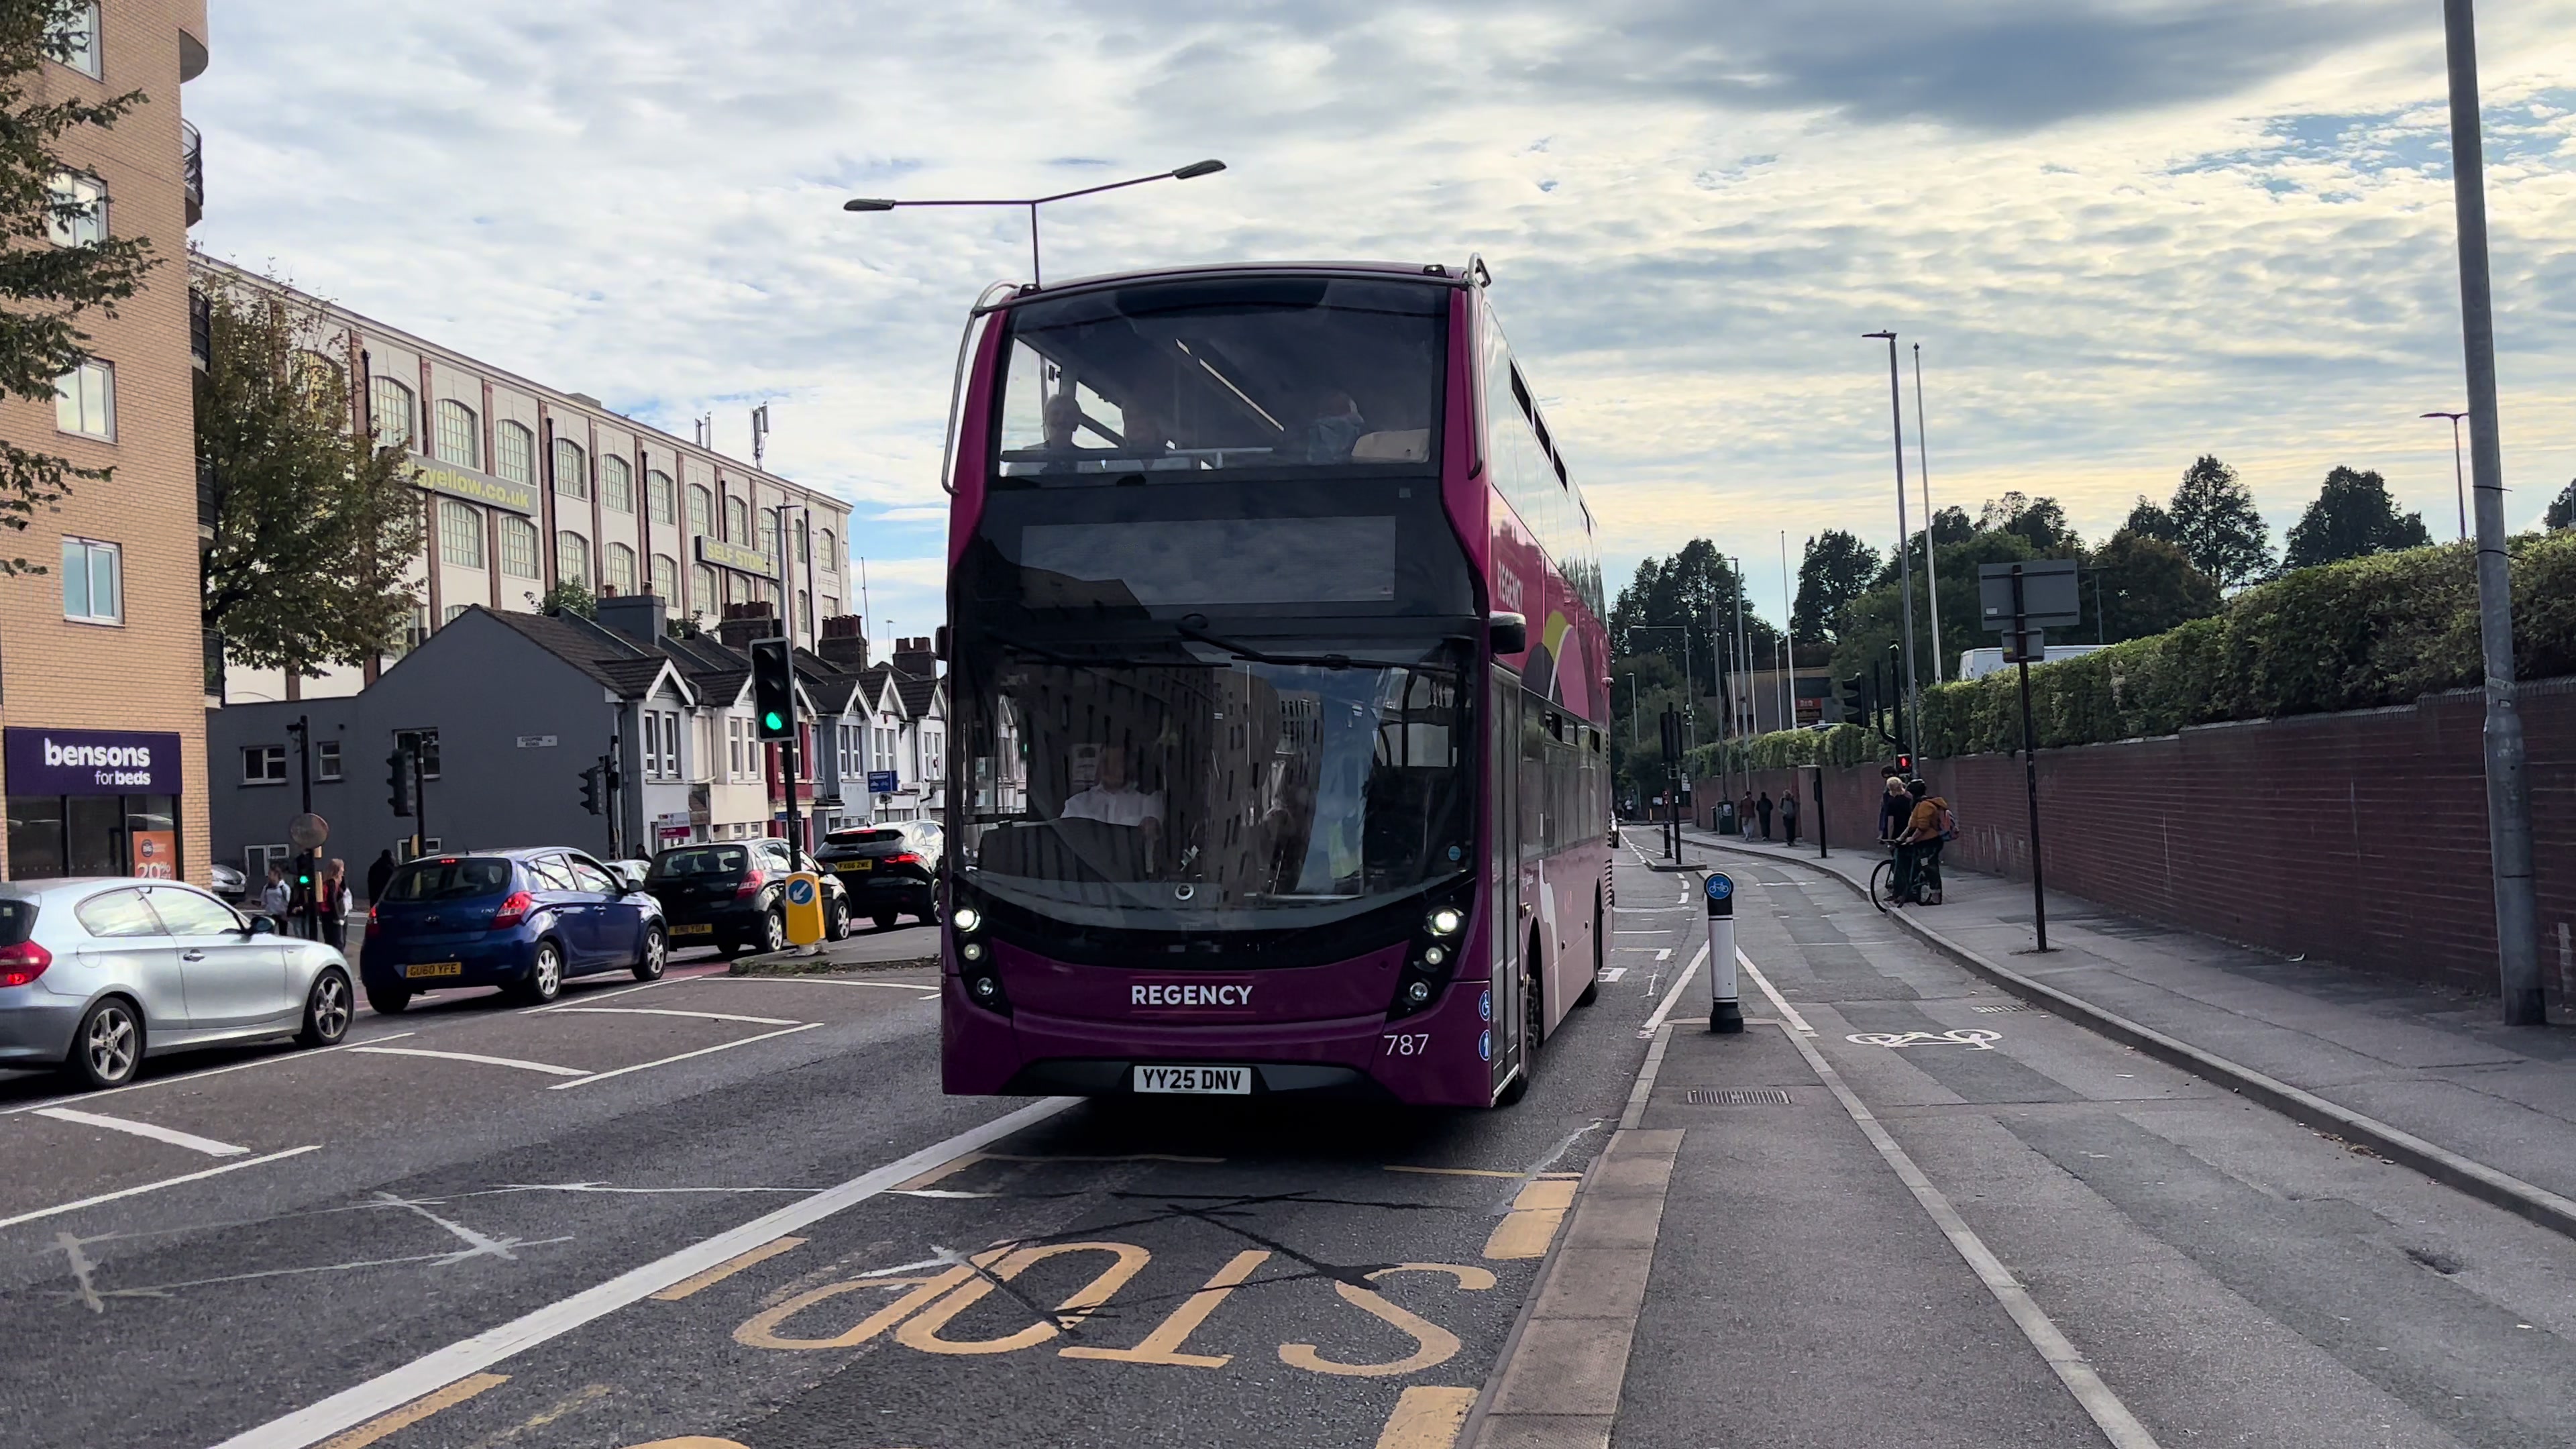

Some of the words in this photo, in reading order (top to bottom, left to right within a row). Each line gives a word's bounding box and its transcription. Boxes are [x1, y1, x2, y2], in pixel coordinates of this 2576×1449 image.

[706, 541, 733, 563] SELF
[1497, 558, 1523, 613] REGENCY
[44, 737, 151, 767] bensons
[95, 771, 113, 785] for
[115, 771, 151, 785] beds
[1132, 985, 1253, 1005] REGENCY
[1383, 1034, 1430, 1056] 787
[1142, 1069, 1195, 1089] YY25
[1201, 1070, 1241, 1090] DNV
[731, 1238, 1497, 1378] STOP
